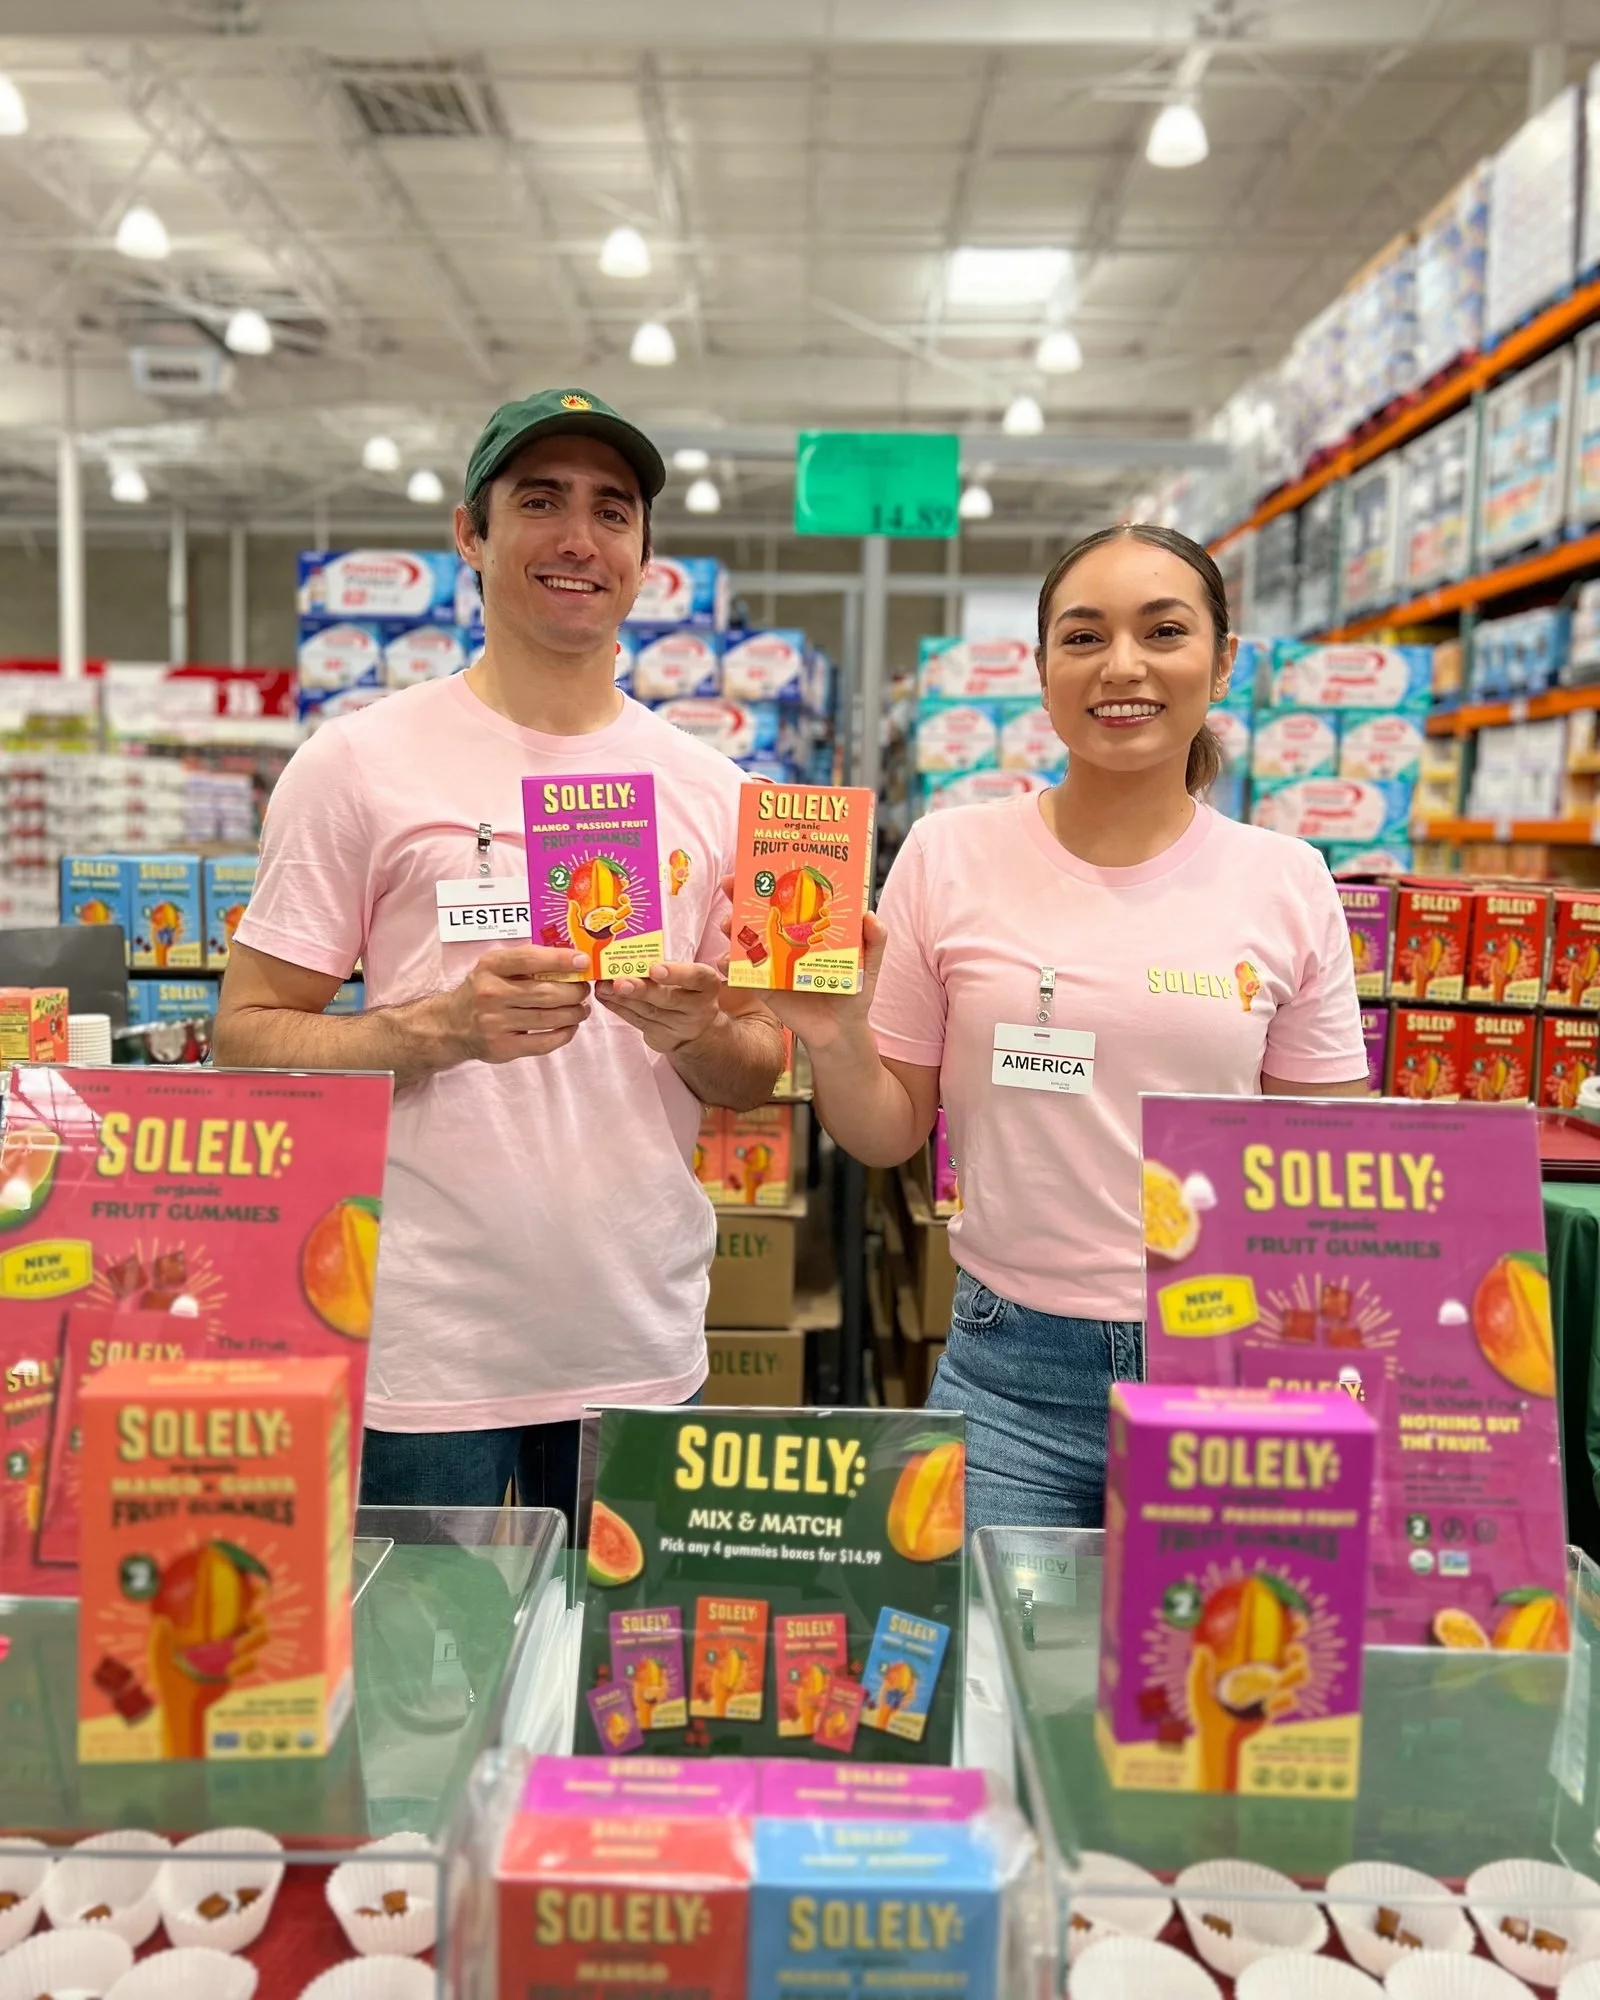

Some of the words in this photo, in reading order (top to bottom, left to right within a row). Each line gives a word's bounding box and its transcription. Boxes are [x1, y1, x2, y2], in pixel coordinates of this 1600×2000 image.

[532, 823, 570, 833] MANGO
[576, 821, 619, 831] PASSION
[621, 820, 648, 829] FRUIT
[753, 828, 800, 840] MANGO
[810, 831, 850, 843] GUAVA
[784, 822, 821, 831] organic
[753, 840, 789, 857] FRUIT
[792, 842, 849, 862] GUMMIES
[554, 871, 566, 885] 2
[760, 876, 770, 890] 2
[449, 907, 530, 926] LESTER
[1002, 1054, 1085, 1076] AMERICA
[153, 1183, 223, 1198] organic
[91, 1201, 161, 1220] FRUIT
[167, 1203, 281, 1224] GUMMIES
[1246, 1236, 1319, 1256] FRUIT
[1325, 1238, 1442, 1259] GUMMIES
[24, 1252, 62, 1270] NEW
[16, 1267, 71, 1287] FLAVOR
[1184, 1289, 1223, 1306] NEW
[1178, 1304, 1235, 1325] FLAVOR
[1400, 1413, 1482, 1431] NOTHING
[1486, 1416, 1520, 1433] BUT
[1401, 1434, 1432, 1451] THE
[688, 1509, 733, 1531] MIX
[738, 1512, 756, 1532] &
[760, 1513, 842, 1537] MATCH
[660, 1537, 685, 1552] Pick
[688, 1542, 709, 1557] any
[713, 1541, 721, 1555] 4
[724, 1544, 778, 1560] gummies
[781, 1544, 815, 1561] boxes
[818, 1548, 836, 1562] for
[839, 1549, 881, 1565] $14.99
